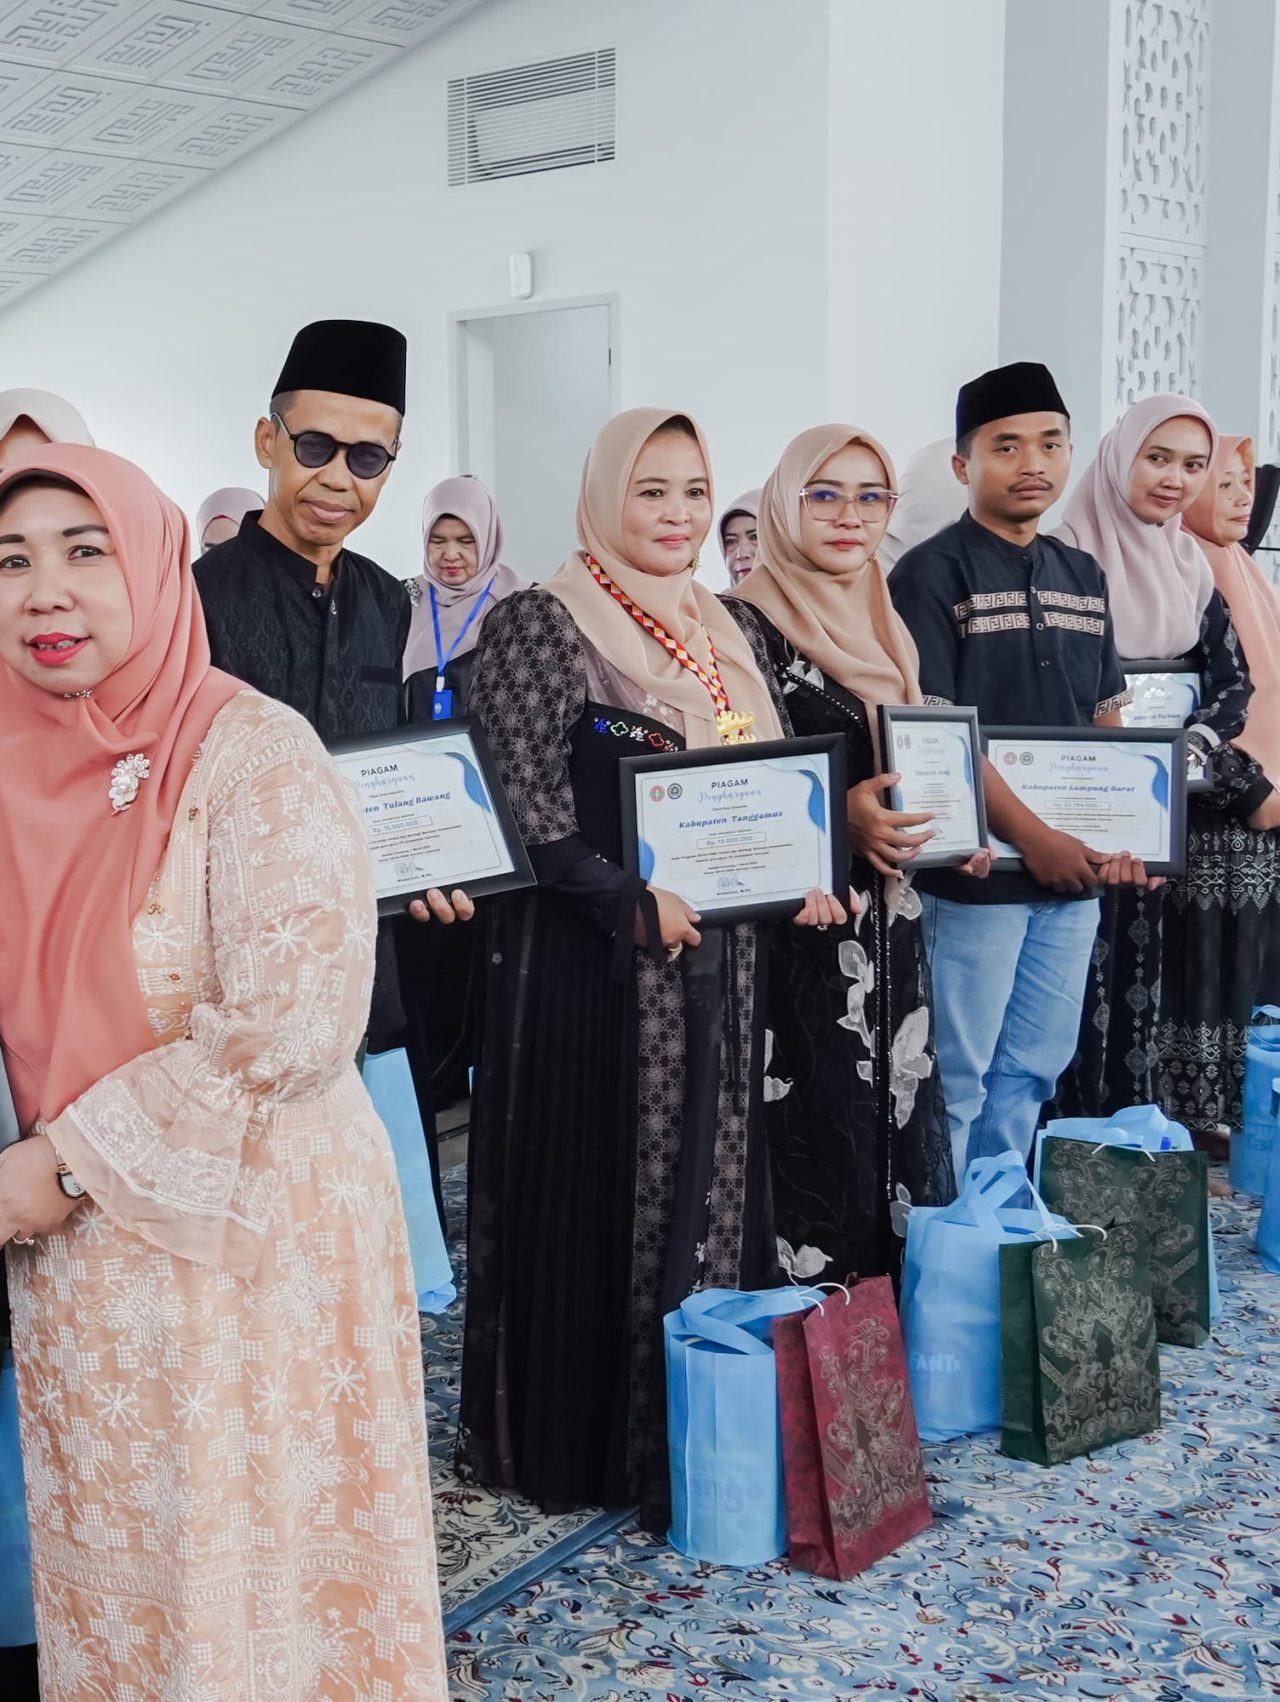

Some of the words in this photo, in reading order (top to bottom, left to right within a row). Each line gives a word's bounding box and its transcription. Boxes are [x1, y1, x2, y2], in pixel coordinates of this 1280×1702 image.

[1061, 754, 1097, 762] PIAGAM
[361, 764, 398, 776] PIAGAM
[711, 778, 749, 789] PIAGAM
[383, 799, 414, 810] Tulang
[416, 791, 450, 803] Bawang
[679, 818, 727, 829] Kabupaten
[732, 811, 783, 822] Tanggamus
